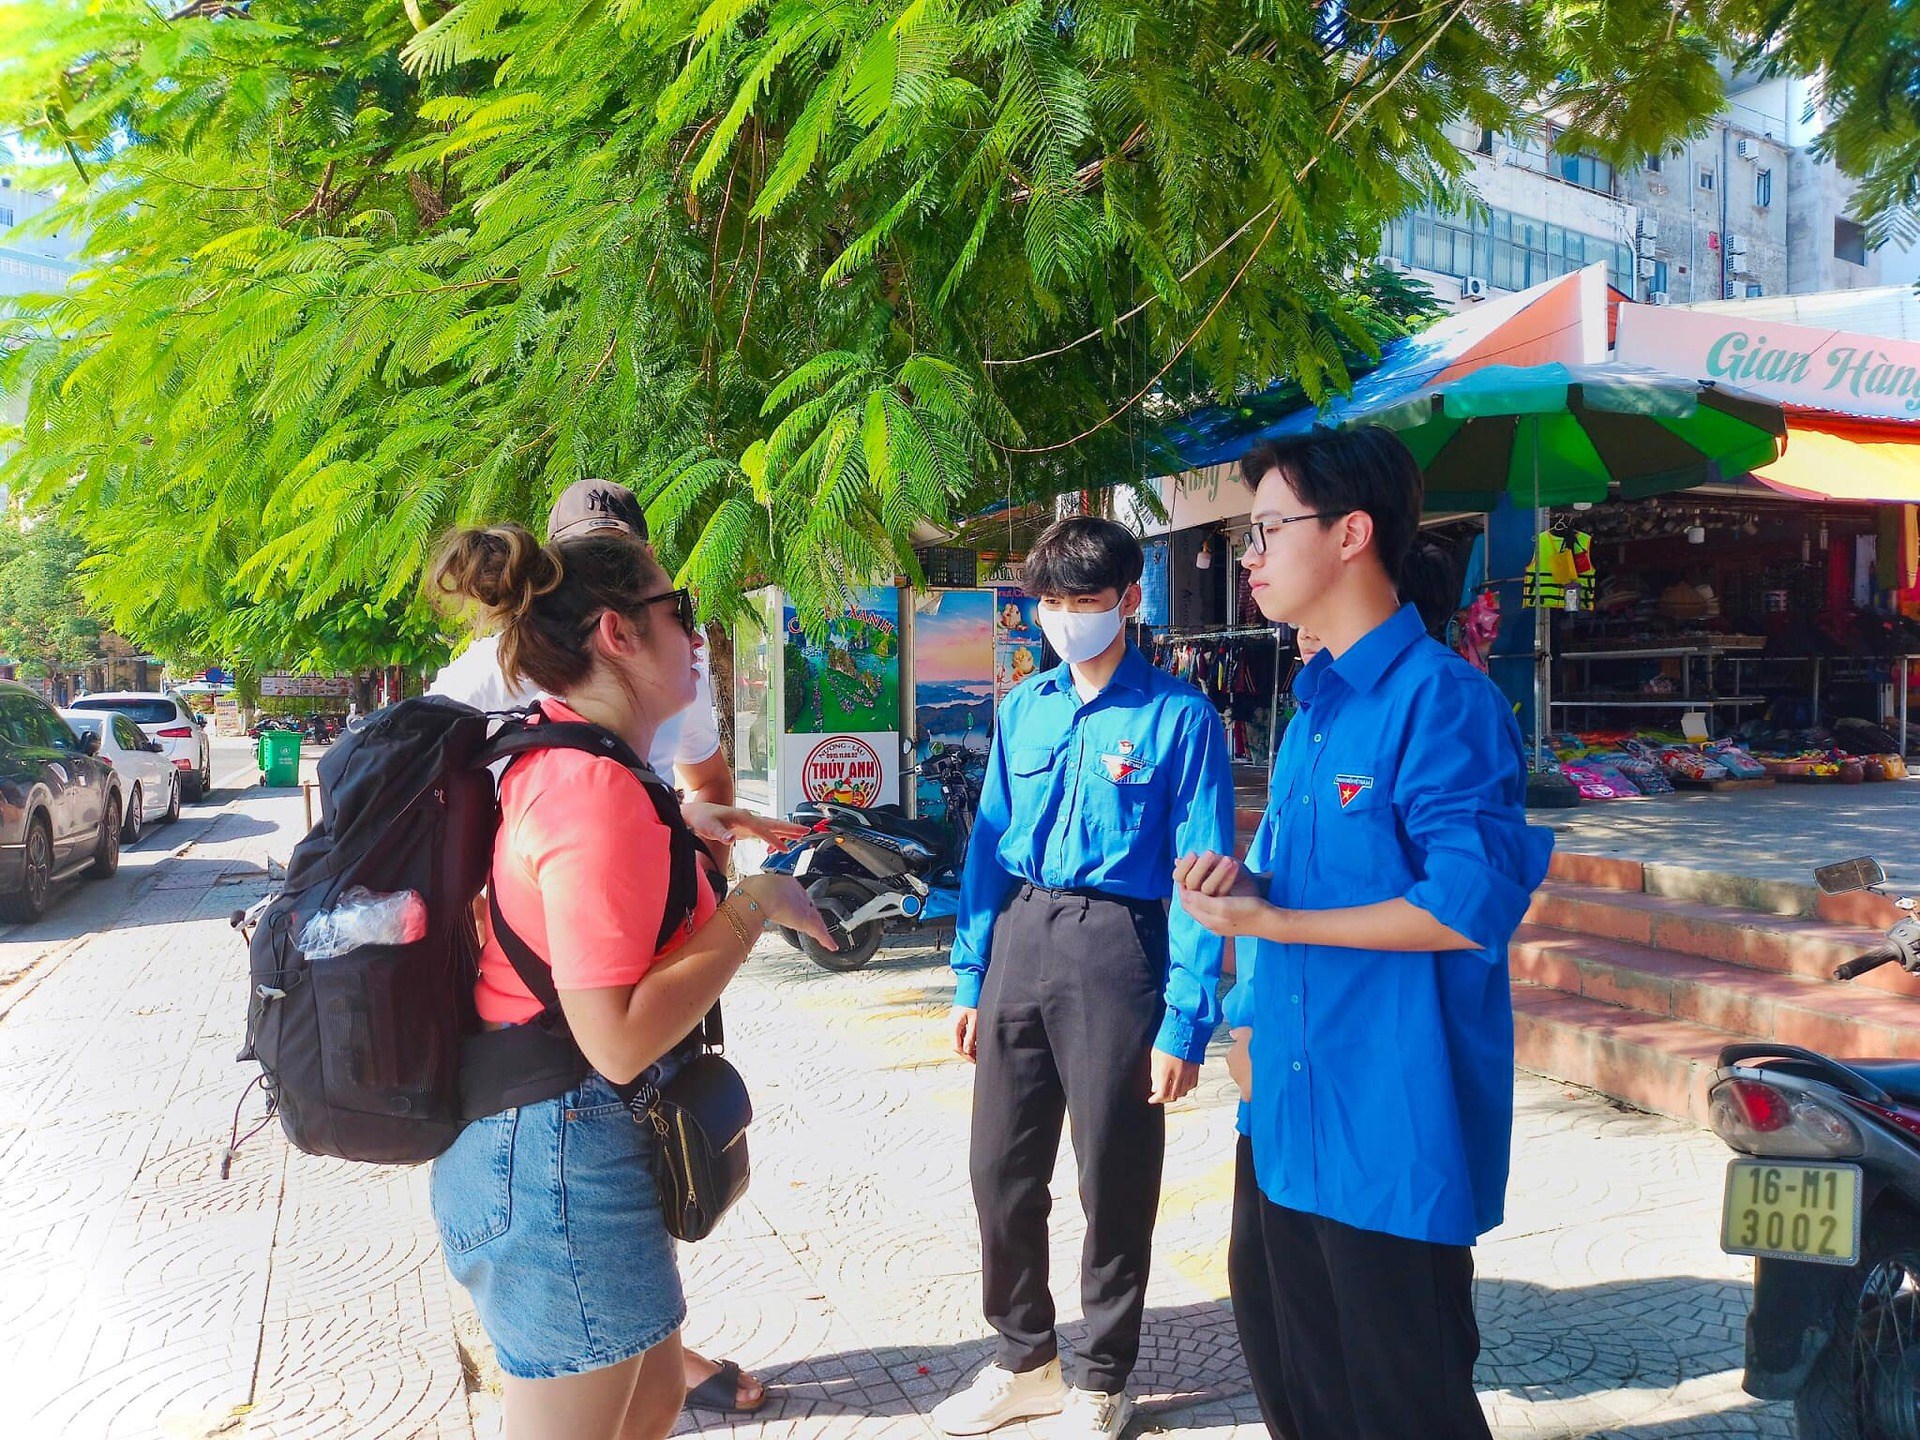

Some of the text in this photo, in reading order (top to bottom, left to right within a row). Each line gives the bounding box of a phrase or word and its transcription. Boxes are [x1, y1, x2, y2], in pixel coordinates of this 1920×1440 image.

[1706, 332, 1810, 383] Gian
[847, 604, 894, 635] XANH
[849, 761, 875, 778] ANH
[1749, 1167, 1837, 1210] 16-M1
[1741, 1208, 1837, 1255] 3002
